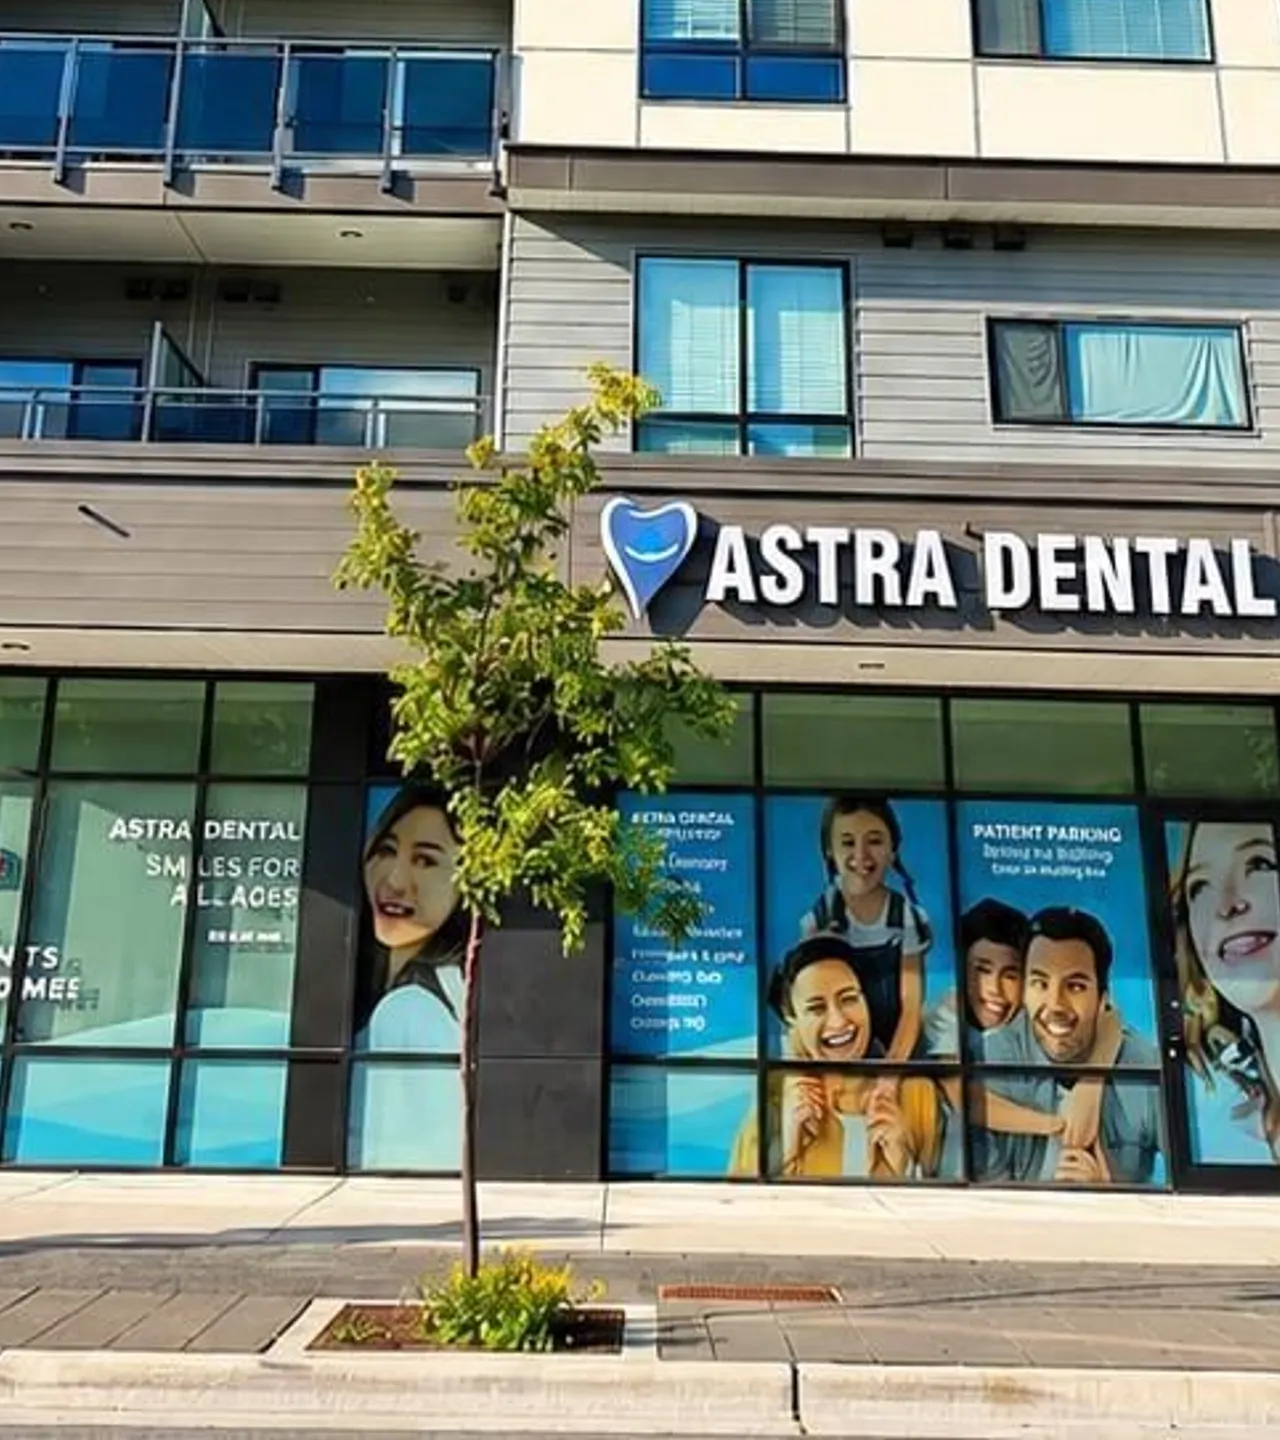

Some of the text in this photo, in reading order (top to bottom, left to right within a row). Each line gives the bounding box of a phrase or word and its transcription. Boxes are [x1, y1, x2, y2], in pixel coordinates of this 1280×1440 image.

[705, 524, 1277, 617] ASTRA DENTAL
[109, 817, 301, 841] ASTRA DENTAL
[146, 854, 301, 878] SMLES FOR
